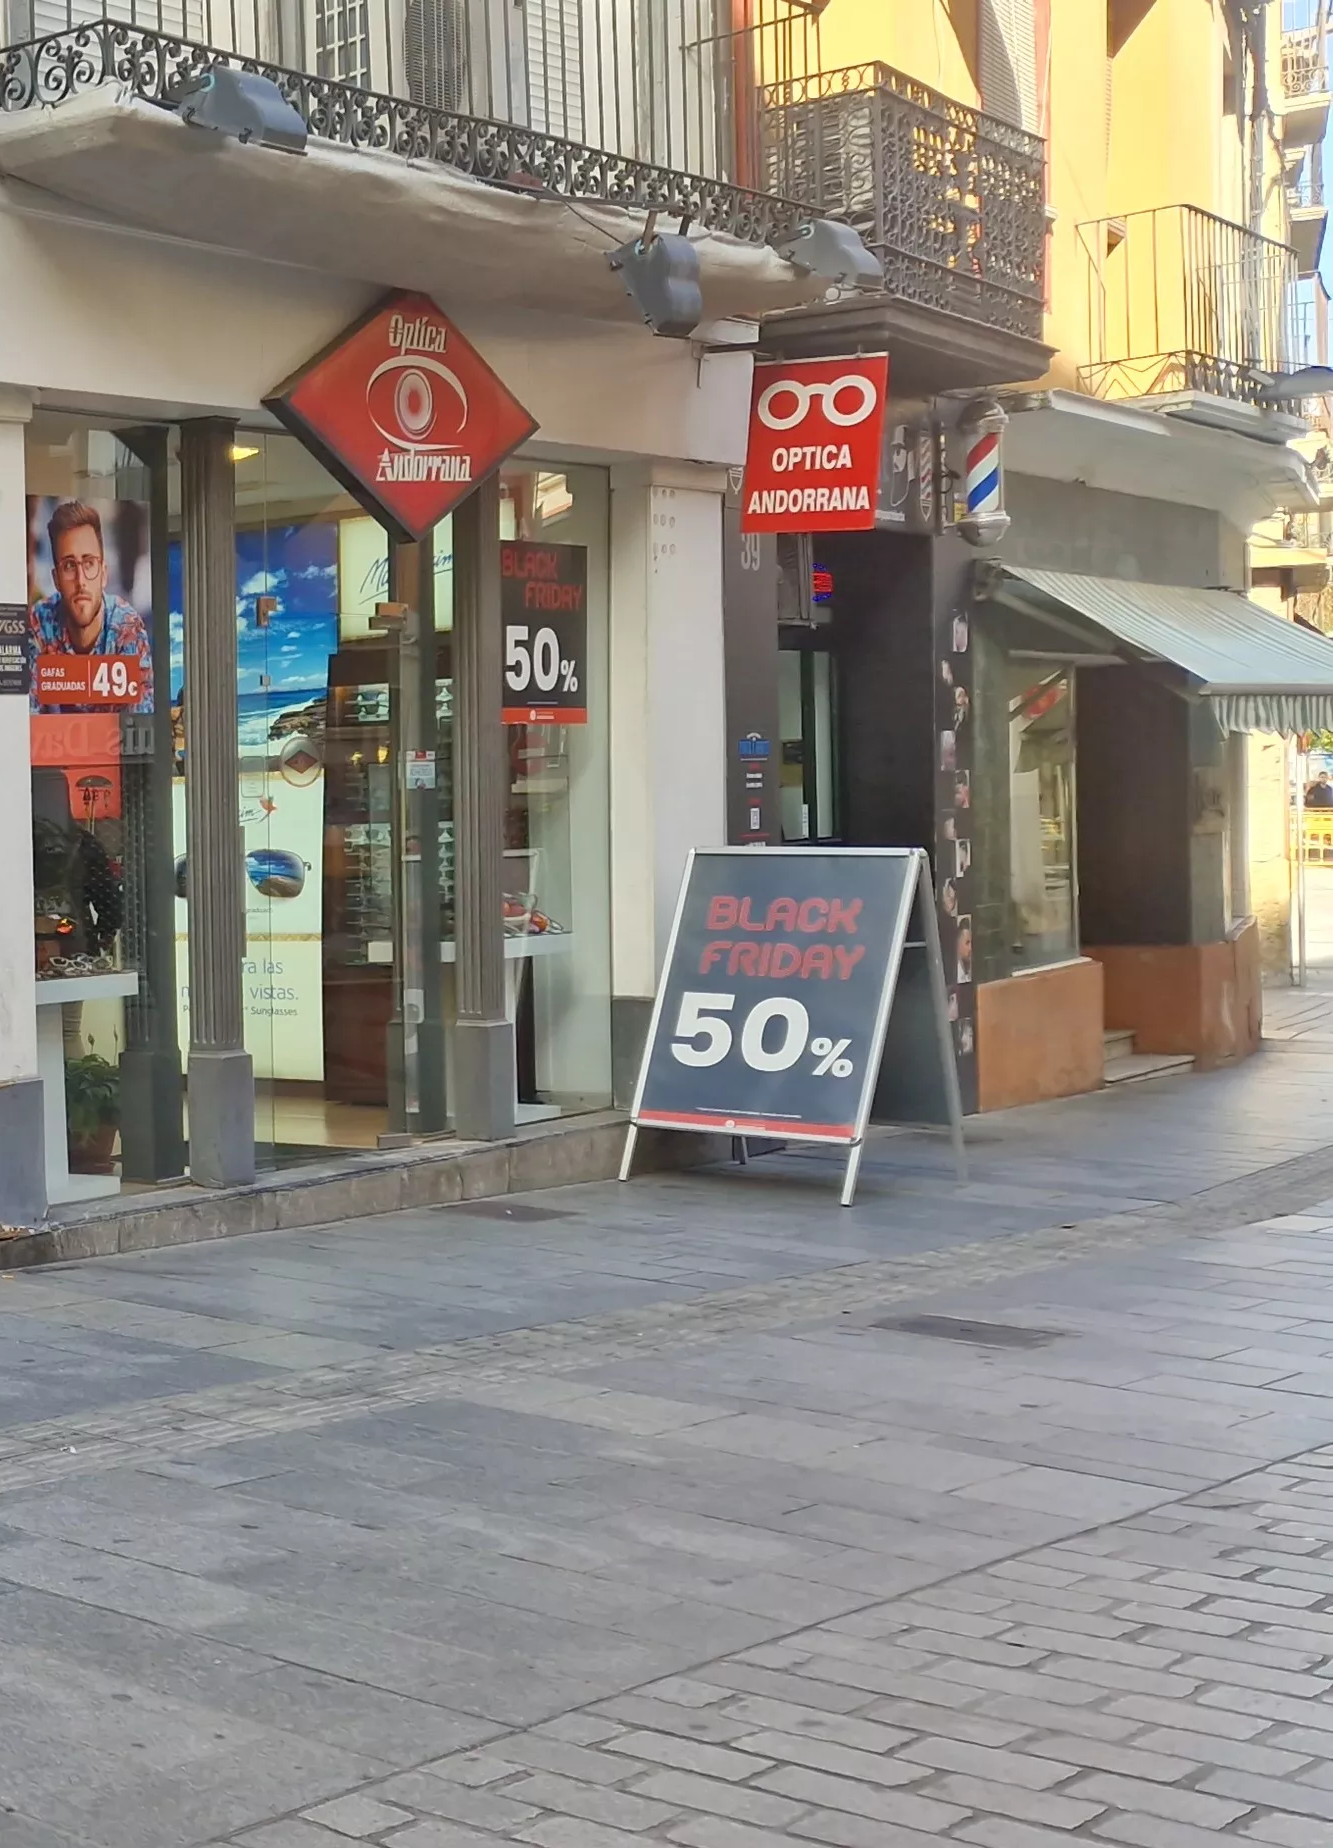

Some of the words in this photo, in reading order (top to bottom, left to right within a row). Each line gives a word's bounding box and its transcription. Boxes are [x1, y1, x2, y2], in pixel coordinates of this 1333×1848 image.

[375, 447, 472, 482] Andorrana
[771, 444, 852, 473] OPTICA
[747, 486, 870, 514] ANDORRANA
[501, 549, 558, 579] BLACK
[524, 582, 582, 611] FRIDAY
[41, 667, 65, 678] GAFAS
[505, 625, 579, 692] 50%
[41, 681, 86, 691] GRADUADAS
[705, 896, 864, 933] BLACK
[263, 958, 284, 975] las
[698, 940, 866, 980] FRIDAY
[670, 991, 854, 1078] 50%
